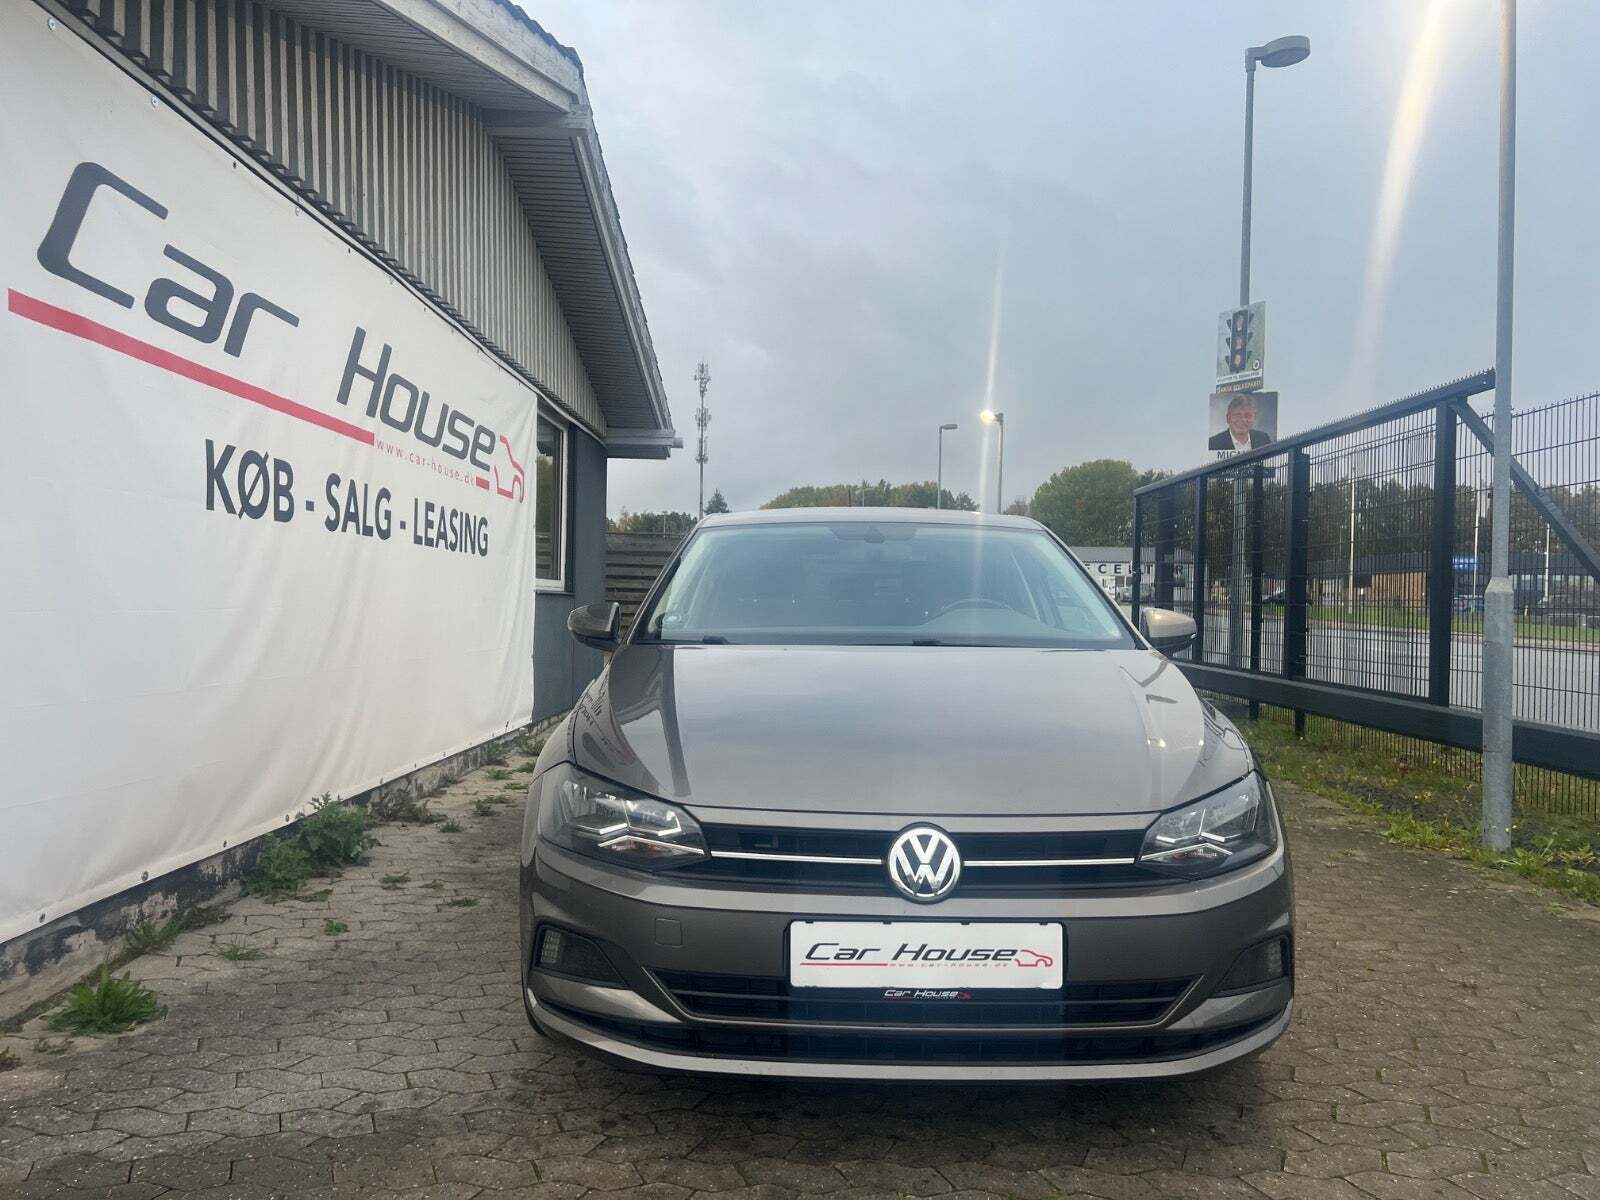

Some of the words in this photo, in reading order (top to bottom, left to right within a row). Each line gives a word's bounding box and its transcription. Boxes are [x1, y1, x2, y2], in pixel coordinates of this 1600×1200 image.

[37, 162, 300, 358] Car
[337, 326, 496, 472] House
[376, 439, 475, 485] www.car-house.dk
[205, 438, 295, 524] KØB
[324, 473, 392, 541] SALG
[413, 497, 489, 558] LEASING
[805, 942, 881, 961] Car
[892, 943, 1017, 961] House
[884, 989, 911, 997] Car
[913, 989, 959, 997] House
